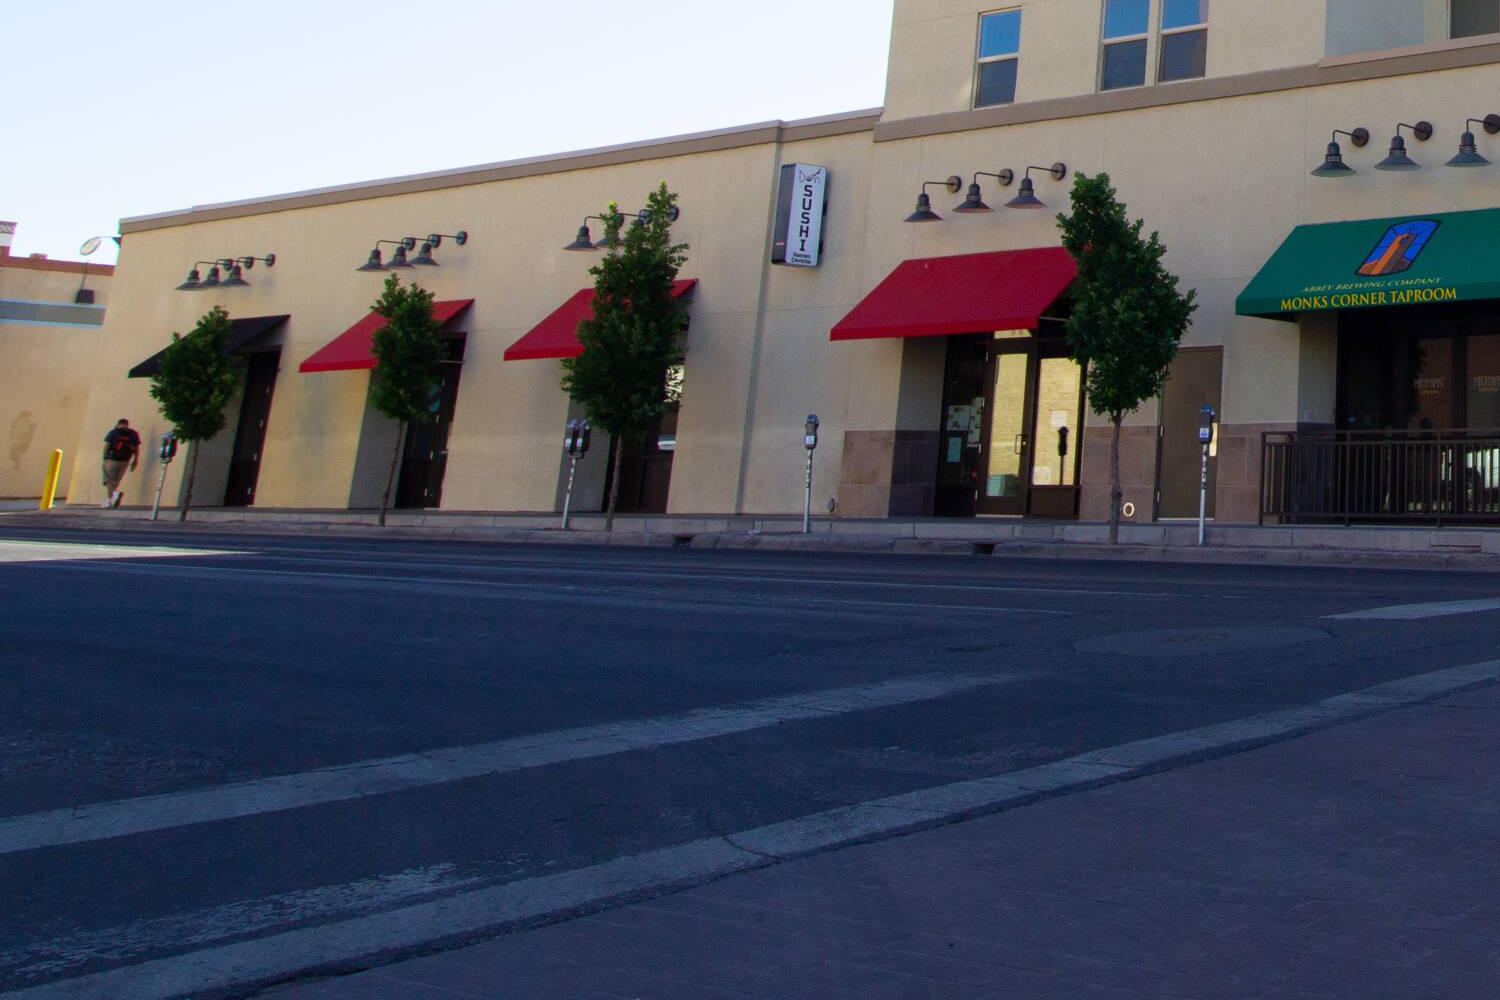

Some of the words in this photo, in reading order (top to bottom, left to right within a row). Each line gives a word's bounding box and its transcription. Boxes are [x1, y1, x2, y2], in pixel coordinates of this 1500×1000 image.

[799, 184, 814, 252] SUSHI
[1303, 284, 1334, 293] ABBEY
[1335, 280, 1387, 291] BREWING
[1387, 277, 1444, 287] COMPANY
[1280, 295, 1328, 311] MONKS
[1330, 291, 1387, 308] CORNER
[1389, 287, 1458, 304] TAPROOM
